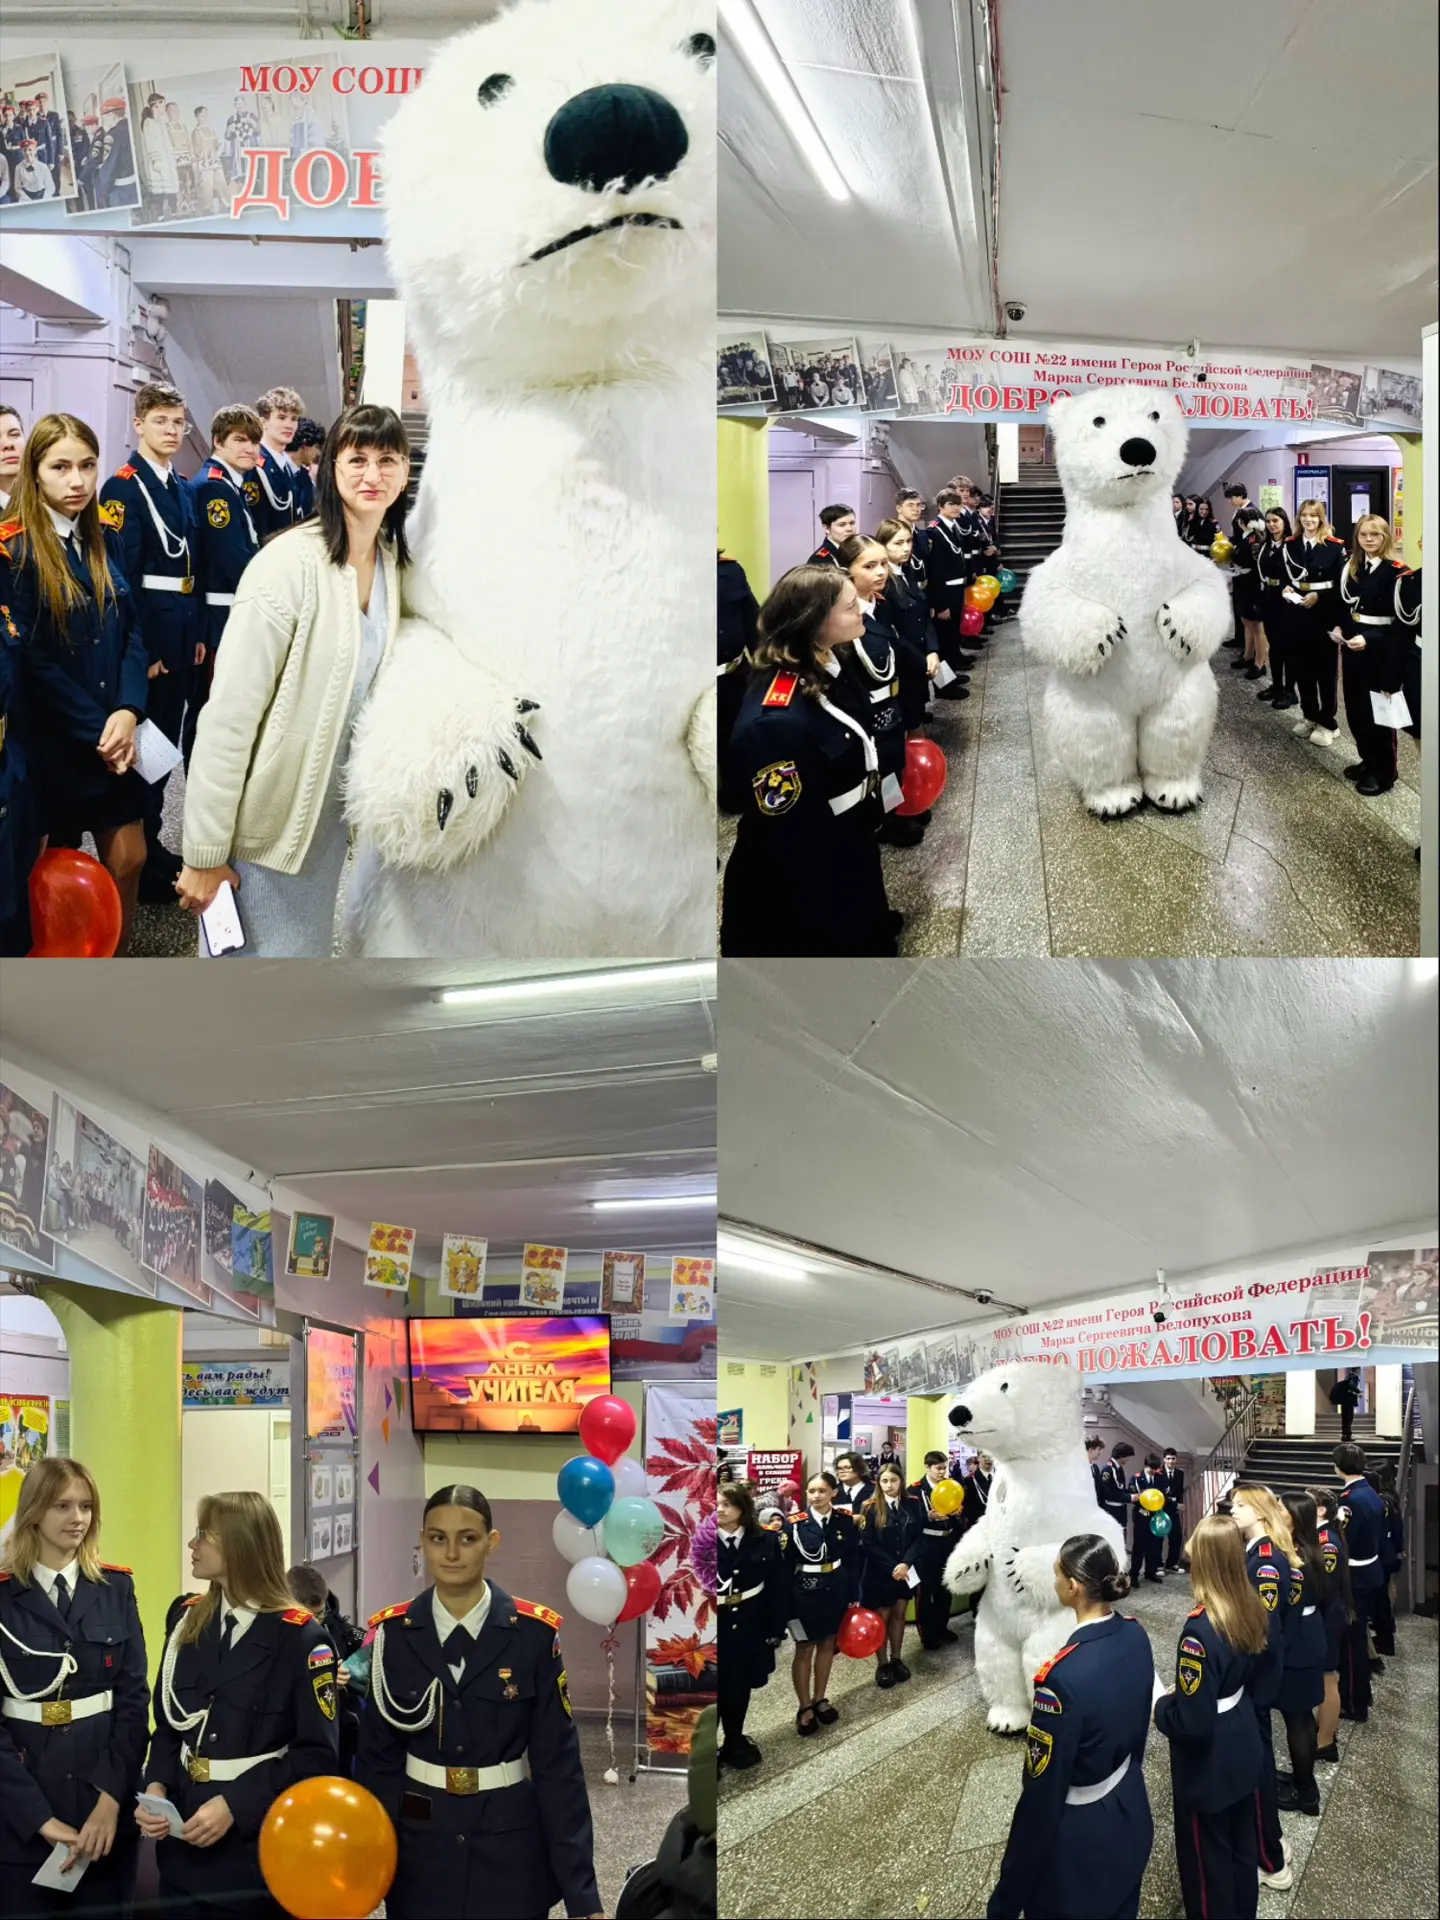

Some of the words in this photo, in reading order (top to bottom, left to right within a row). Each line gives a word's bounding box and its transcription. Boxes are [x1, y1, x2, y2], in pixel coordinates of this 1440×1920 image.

[239, 66, 323, 93] МОУ
[231, 148, 385, 220] ДОБ
[947, 348, 985, 361] МОУ
[990, 350, 1031, 364] СОШ
[1035, 353, 1067, 366] №22
[1071, 358, 1117, 369] имени
[1121, 358, 1162, 373] Героя
[1245, 365, 1313, 380] Федерации
[1033, 370, 1082, 385] Марка
[1172, 377, 1248, 392] Белопухова
[993, 1329, 1013, 1341] МОУ
[1015, 1322, 1040, 1337] СОШ
[1042, 1318, 1065, 1331] №22
[1066, 1314, 1103, 1328] имени
[1106, 1306, 1145, 1322] Героя
[1248, 1265, 1371, 1299] Федерации
[1041, 1336, 1075, 1349] Марка
[1077, 1324, 1150, 1346] Сергеевича
[1077, 1312, 1372, 1374] ПОЖАЛОВАТЬ!
[505, 1341, 533, 1360] С
[196, 1373, 224, 1381] вам
[226, 1368, 272, 1382] рады!
[483, 1363, 558, 1376] ДНЕМ
[215, 1387, 240, 1396] вас
[243, 1385, 289, 1398] ждут
[466, 1378, 579, 1404] УЧИТЕЛЯ
[751, 1453, 799, 1464] НАБОР
